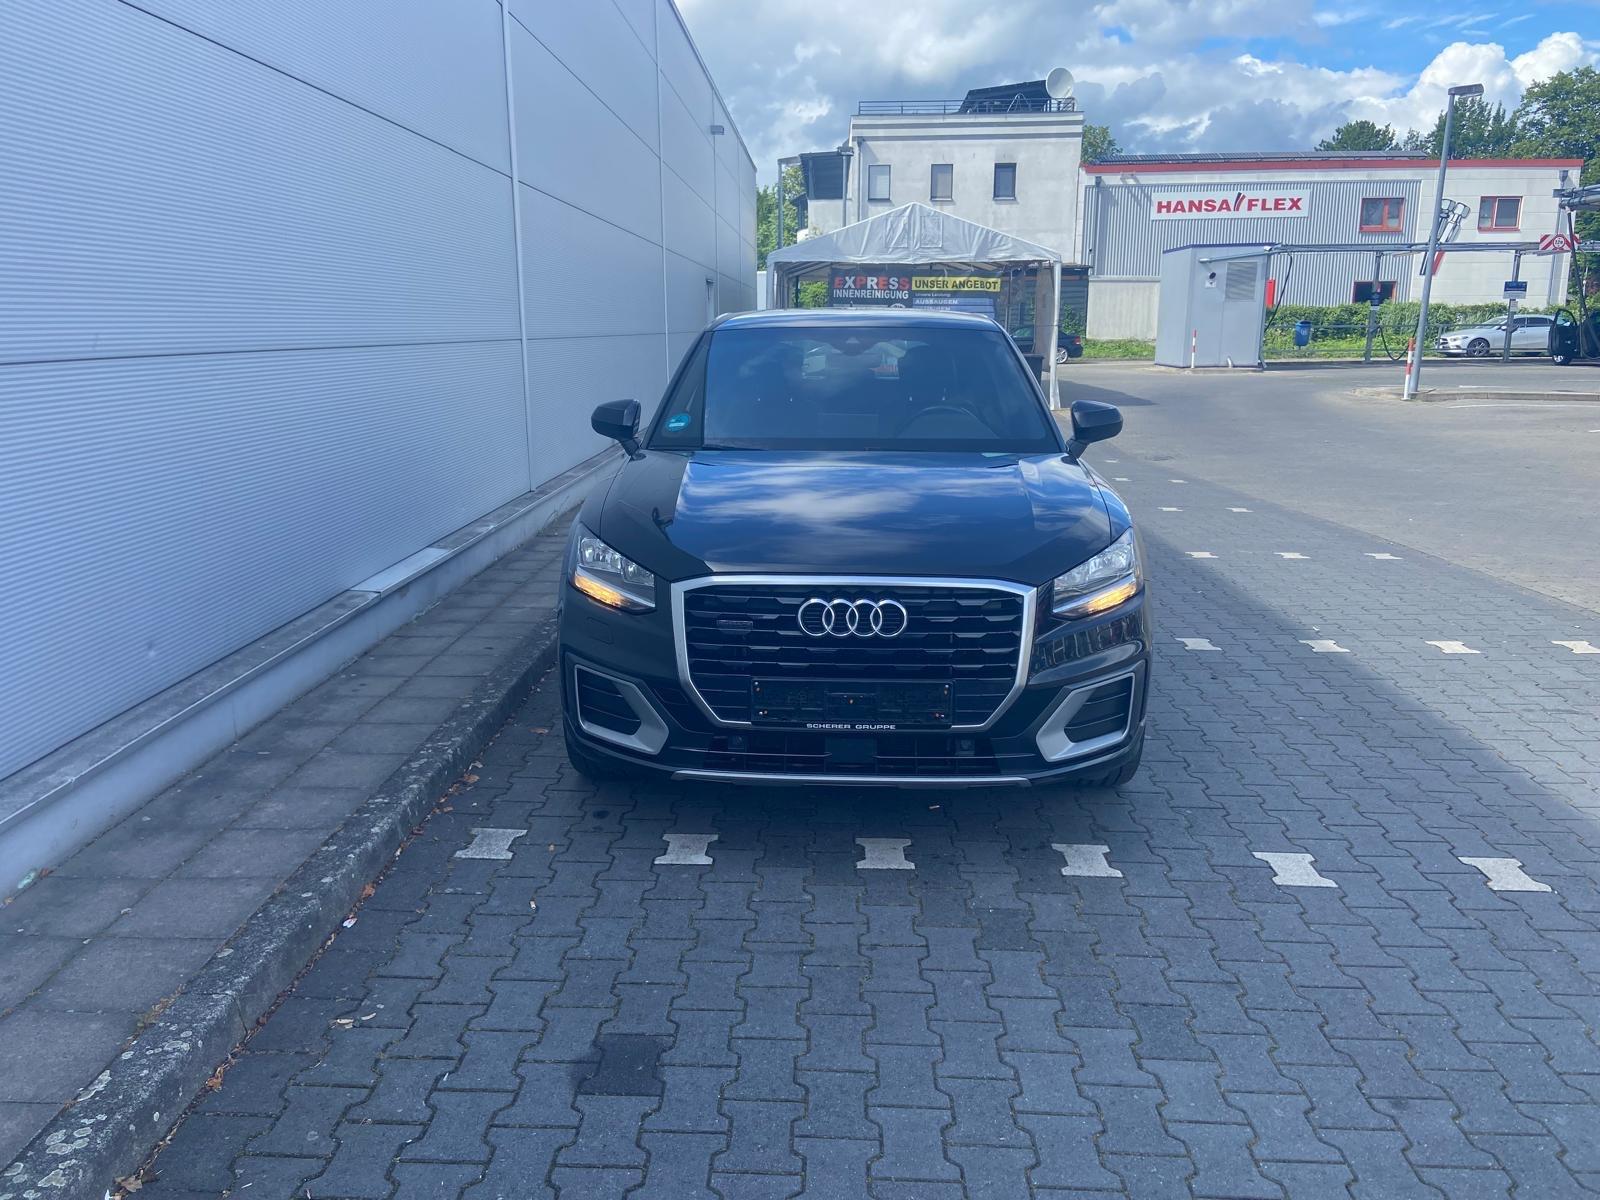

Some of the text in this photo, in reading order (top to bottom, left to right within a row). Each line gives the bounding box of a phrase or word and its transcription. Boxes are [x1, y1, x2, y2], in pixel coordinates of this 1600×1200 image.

[834, 276, 910, 290] EXPRESS
[914, 279, 999, 290] UNSER ANGEBOT
[833, 289, 909, 300] INNENREINIGUNG
